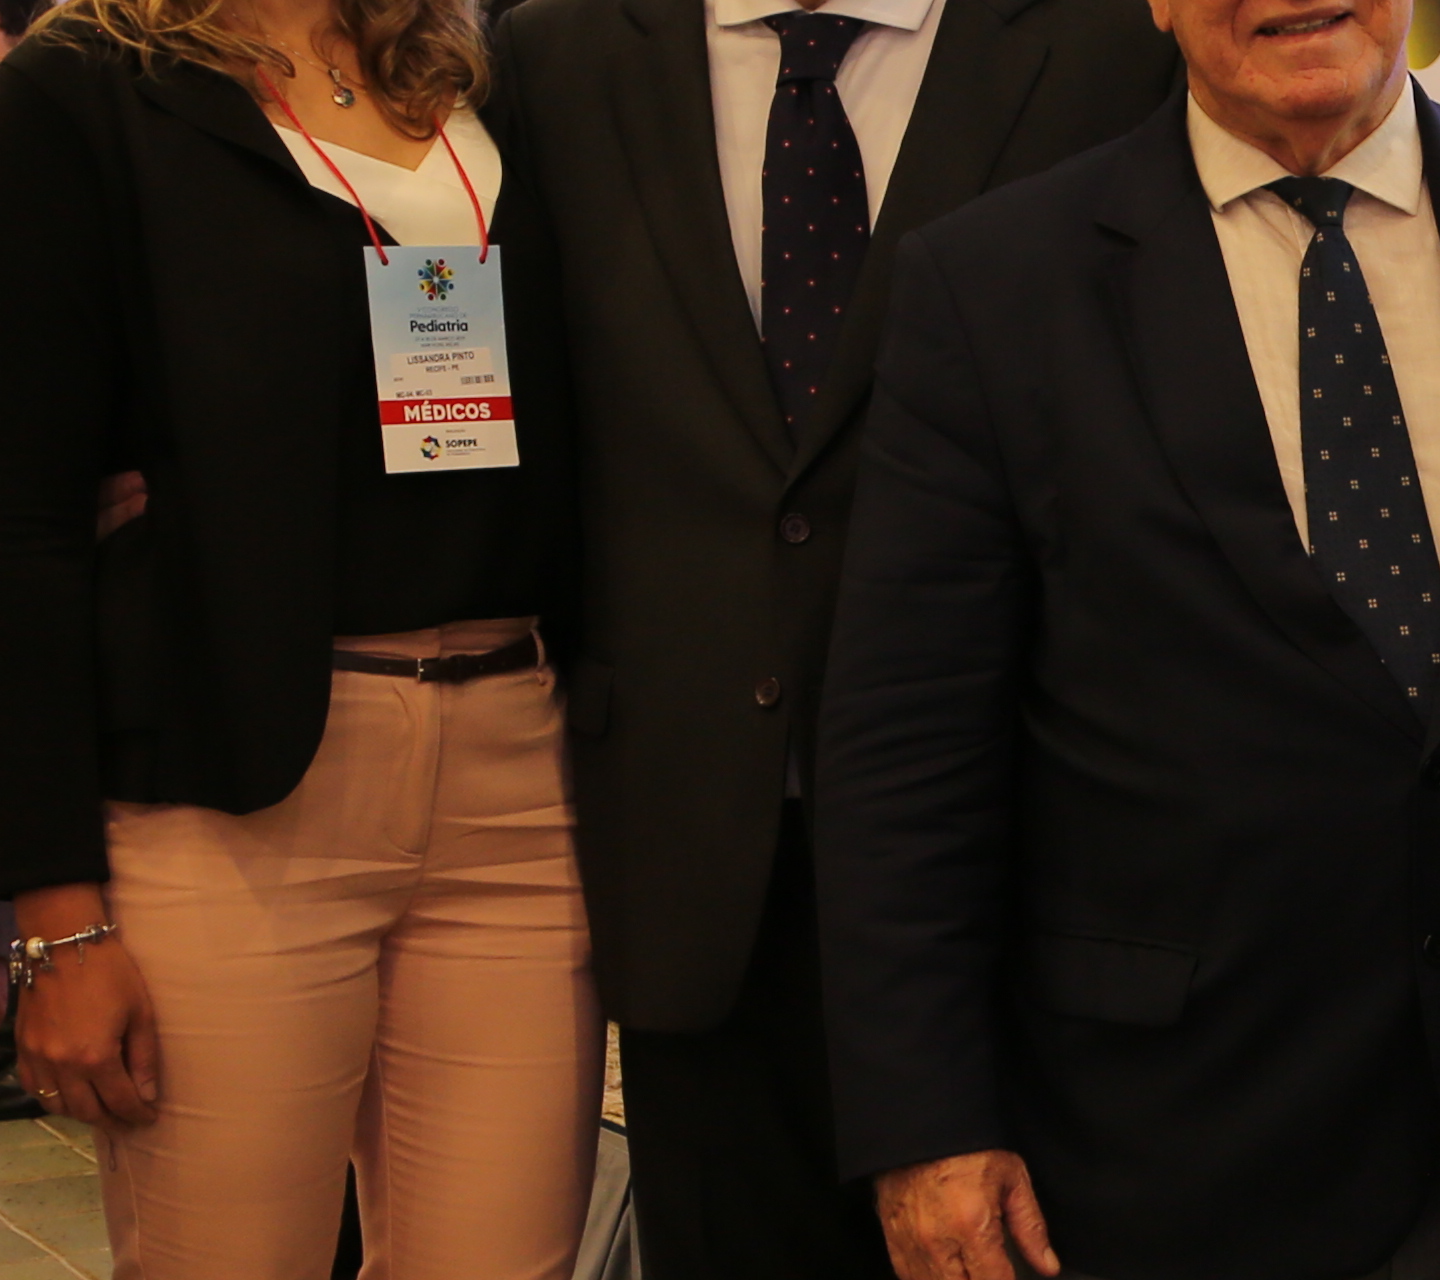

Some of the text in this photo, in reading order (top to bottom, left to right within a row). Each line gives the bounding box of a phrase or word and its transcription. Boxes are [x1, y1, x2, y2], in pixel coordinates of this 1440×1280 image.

[410, 319, 468, 332] Pediatria
[407, 351, 474, 365] LISSANDRA PINTO
[404, 400, 491, 422] MÉDICOS
[445, 438, 478, 448] SOPEPE
